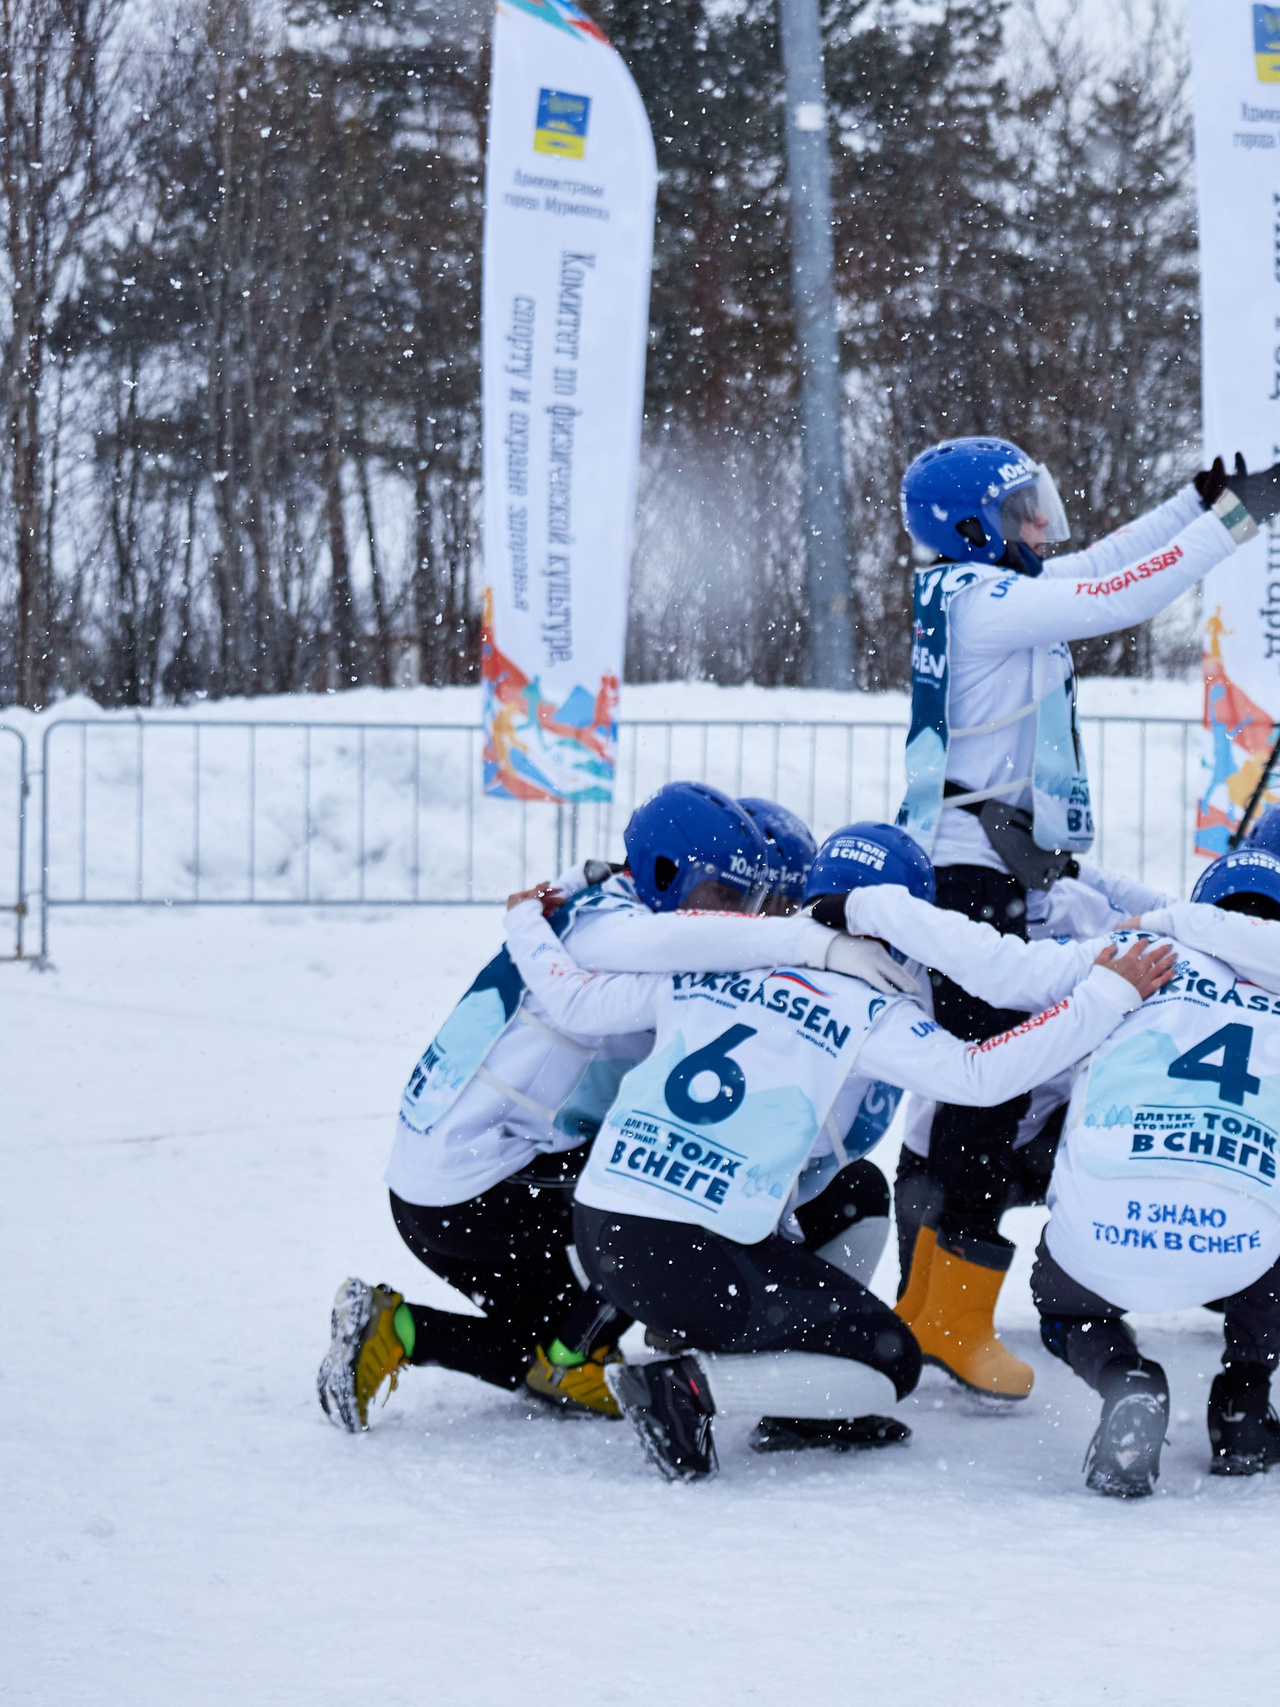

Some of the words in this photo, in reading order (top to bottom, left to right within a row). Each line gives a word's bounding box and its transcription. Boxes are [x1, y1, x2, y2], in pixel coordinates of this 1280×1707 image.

[555, 249, 596, 361] Комитет
[504, 293, 536, 381] спорту
[508, 386, 532, 403] и
[552, 366, 577, 396] по
[504, 411, 531, 497] охране
[857, 841, 888, 860] ТОЛК
[665, 1023, 758, 1126] 6
[1168, 1022, 1261, 1106] 4
[624, 1117, 642, 1130] ДЛЯ
[1134, 1112, 1164, 1122] ДЛЯ
[1134, 1122, 1157, 1131] КТО
[1158, 1121, 1196, 1131] ЗНАЕТ
[1203, 1112, 1277, 1154] ТОЛК
[610, 1140, 627, 1164] В
[627, 1146, 730, 1205] СНЕГЕ
[666, 1131, 742, 1178] ТОЛК
[1131, 1134, 1155, 1153] В
[1163, 1131, 1276, 1179] СНЕГЕ
[1127, 1200, 1142, 1220] Я
[1147, 1203, 1227, 1229] ЗНАЮ
[1093, 1220, 1158, 1249] ТОЛК
[1164, 1231, 1183, 1251] В
[1188, 1230, 1262, 1254] СНЕГЕ
